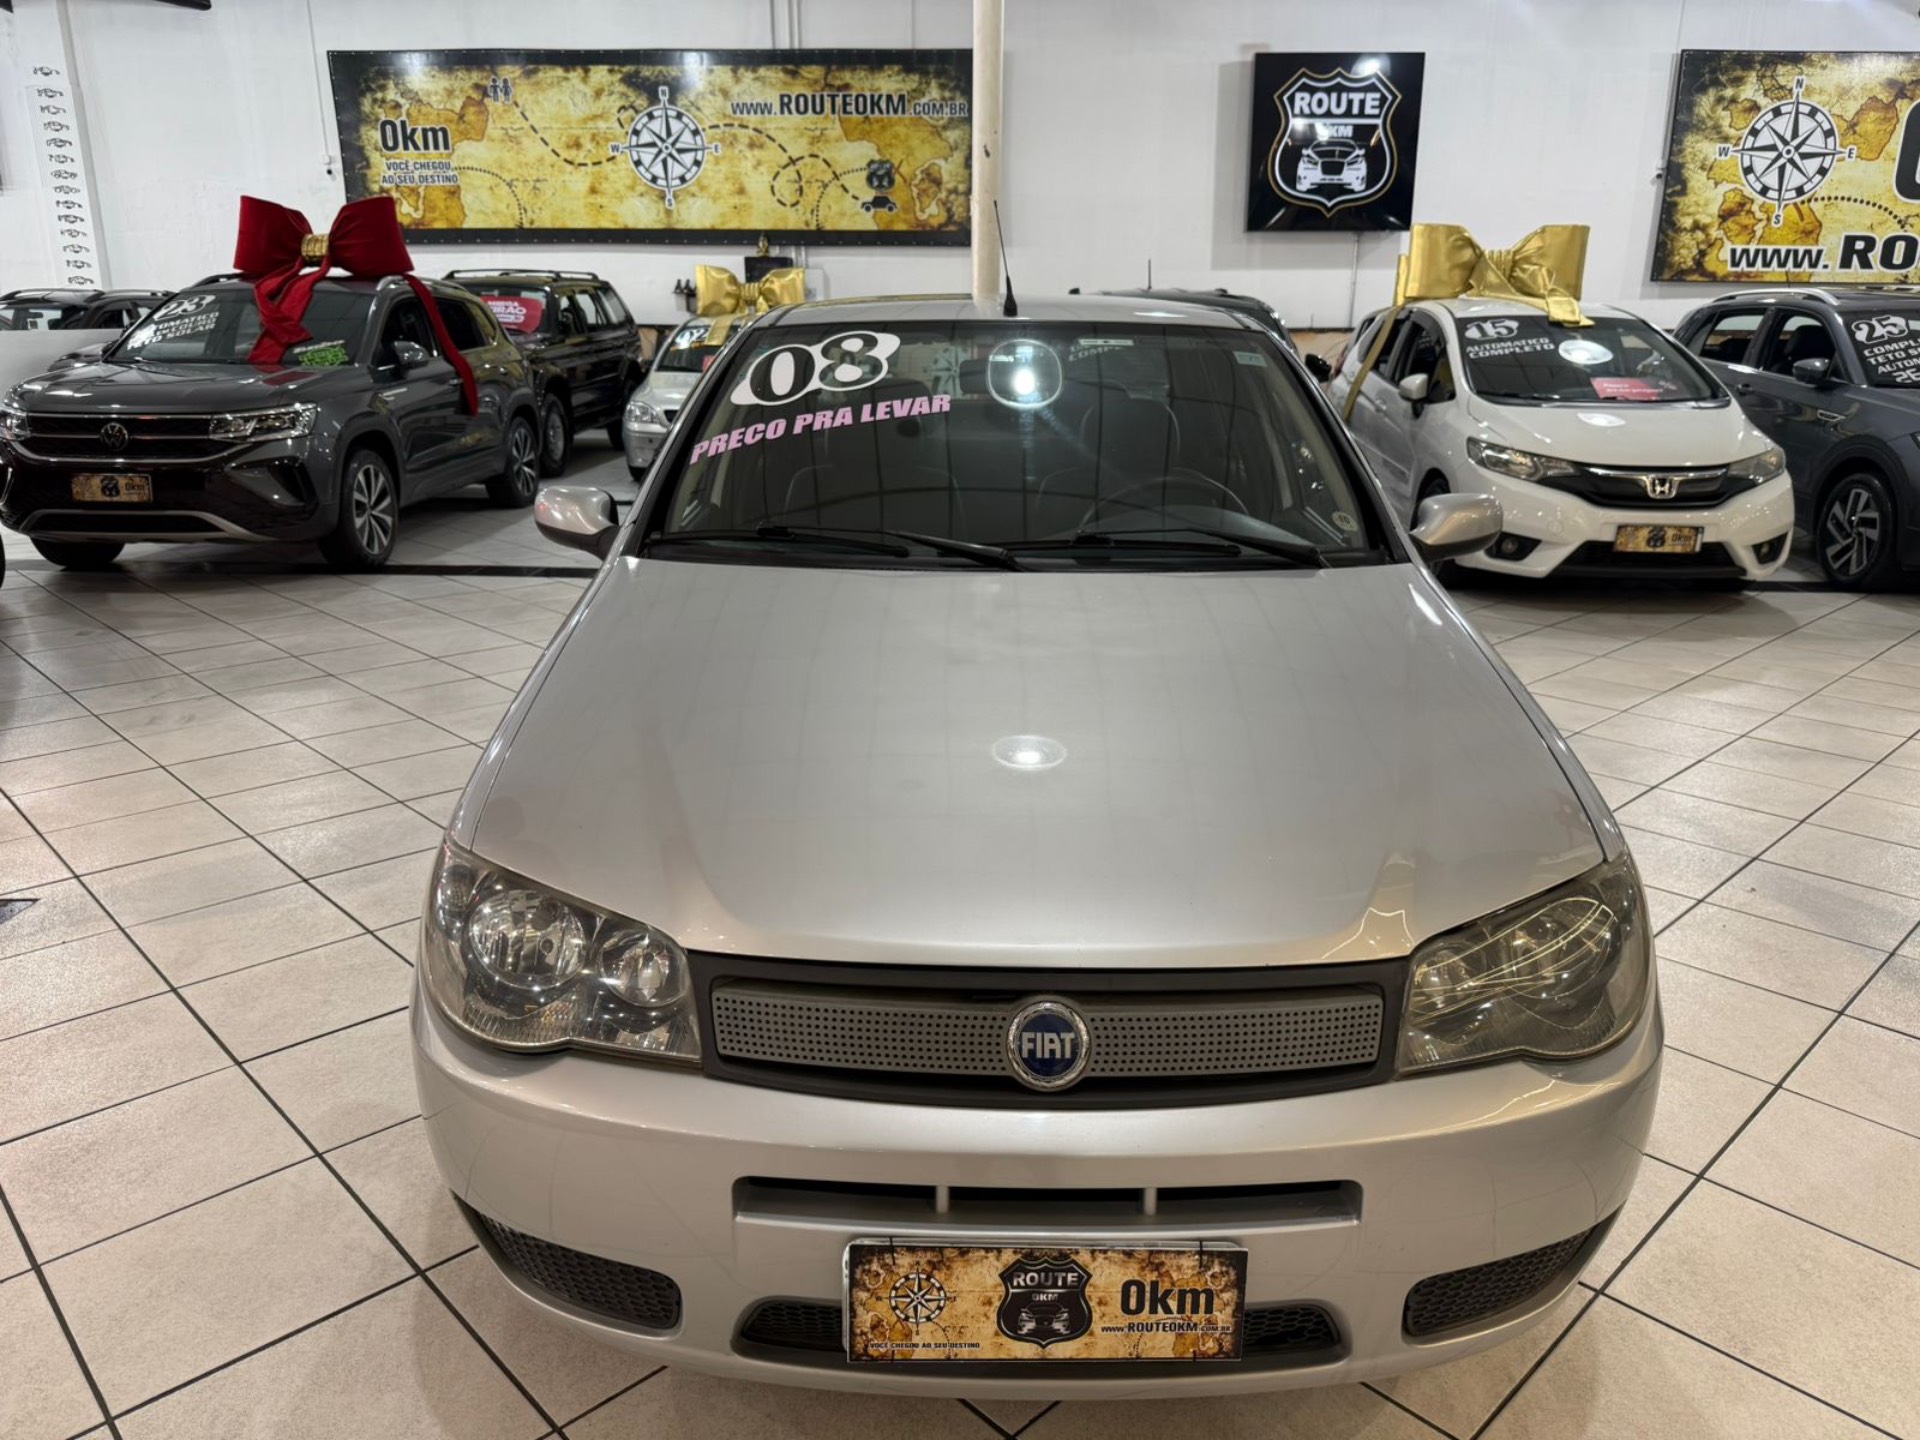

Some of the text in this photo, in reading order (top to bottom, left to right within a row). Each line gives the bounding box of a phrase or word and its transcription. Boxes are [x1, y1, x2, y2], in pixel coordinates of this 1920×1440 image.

[1794, 77, 1804, 89] N
[1293, 92, 1381, 115] ROUTE
[1315, 124, 1353, 138] KM
[610, 144, 620, 153] W
[714, 143, 721, 153] E
[1717, 146, 1731, 157] W
[1847, 147, 1856, 159] E
[413, 161, 452, 171] CHEGOU
[382, 174, 458, 184] AO SEU DESTINO
[1773, 214, 1782, 225] S
[153, 294, 217, 321] 23
[1465, 319, 1519, 340] 15
[1851, 314, 1909, 345] 25
[1466, 337, 1550, 354] AUTOMATICO
[1469, 343, 1555, 359] COMPLETO
[1863, 338, 1920, 357] COMPL
[1867, 350, 1907, 365] TETO
[730, 329, 901, 407] 08
[689, 394, 951, 466] PRECO PRA LEVAR
[1021, 1031, 1076, 1059] FIAT
[1012, 1271, 1079, 1287] ROUTE
